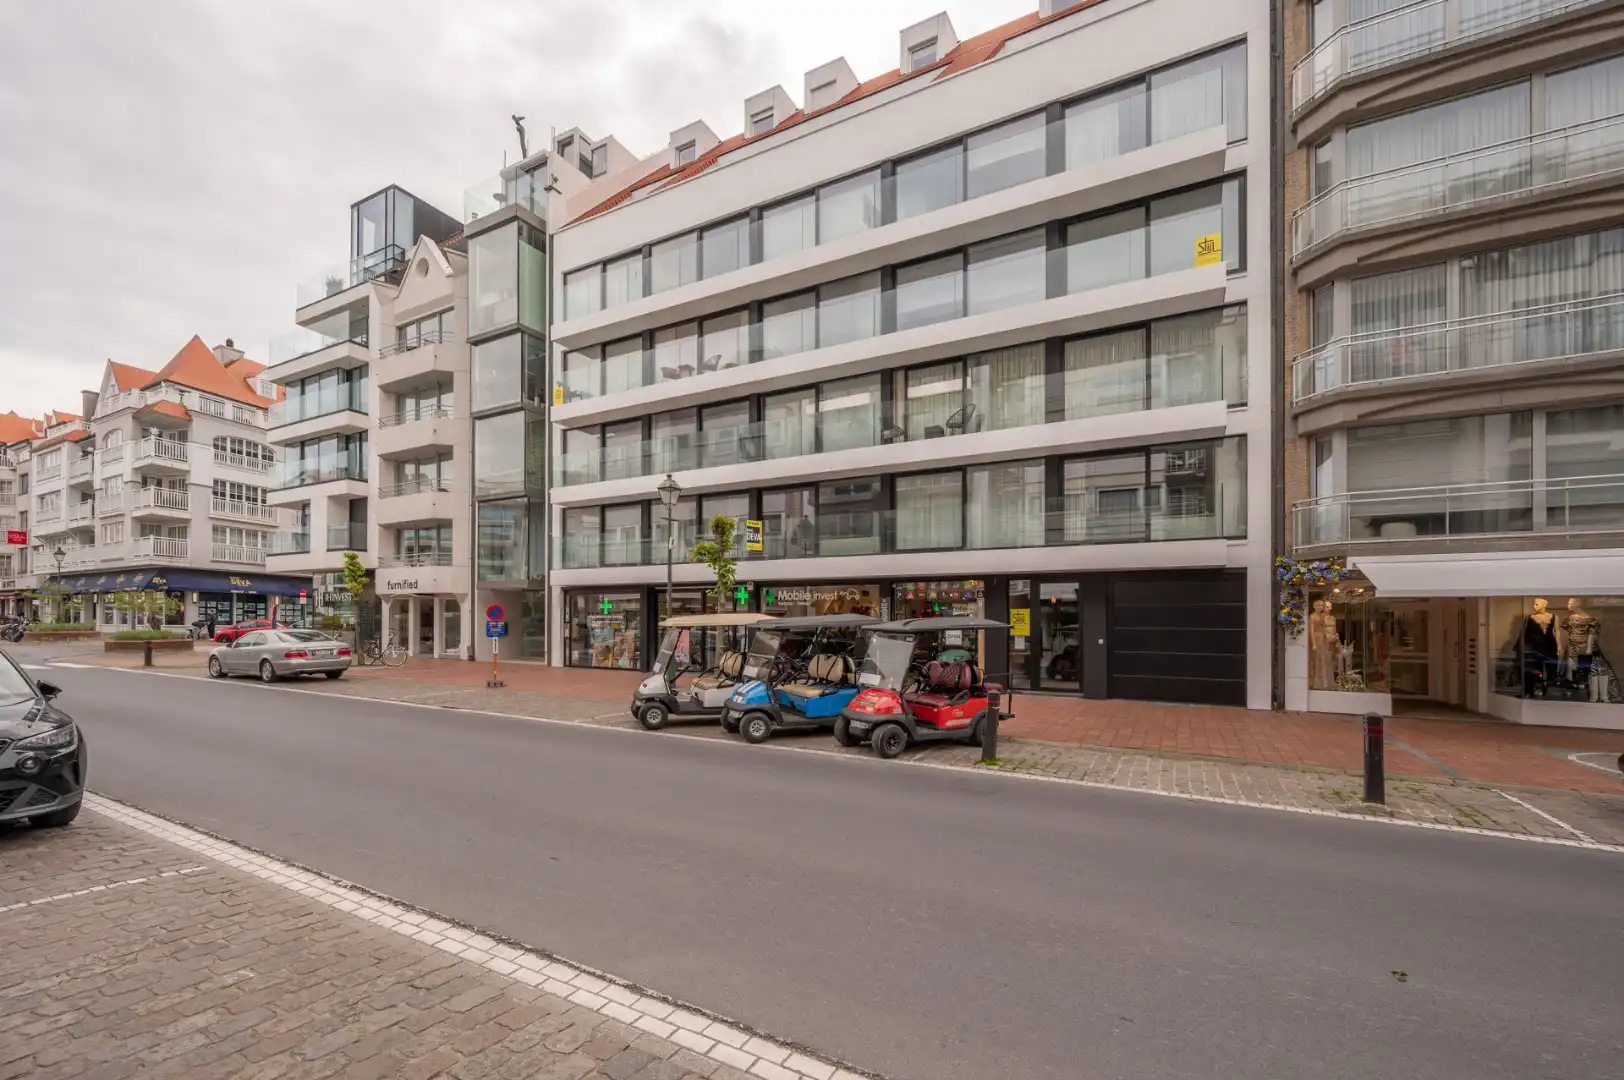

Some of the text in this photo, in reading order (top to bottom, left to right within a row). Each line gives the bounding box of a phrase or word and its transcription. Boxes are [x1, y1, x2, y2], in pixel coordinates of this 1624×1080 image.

[747, 532, 760, 541] DEVA
[387, 579, 418, 590] furnified
[778, 589, 837, 601] Mobile invest
